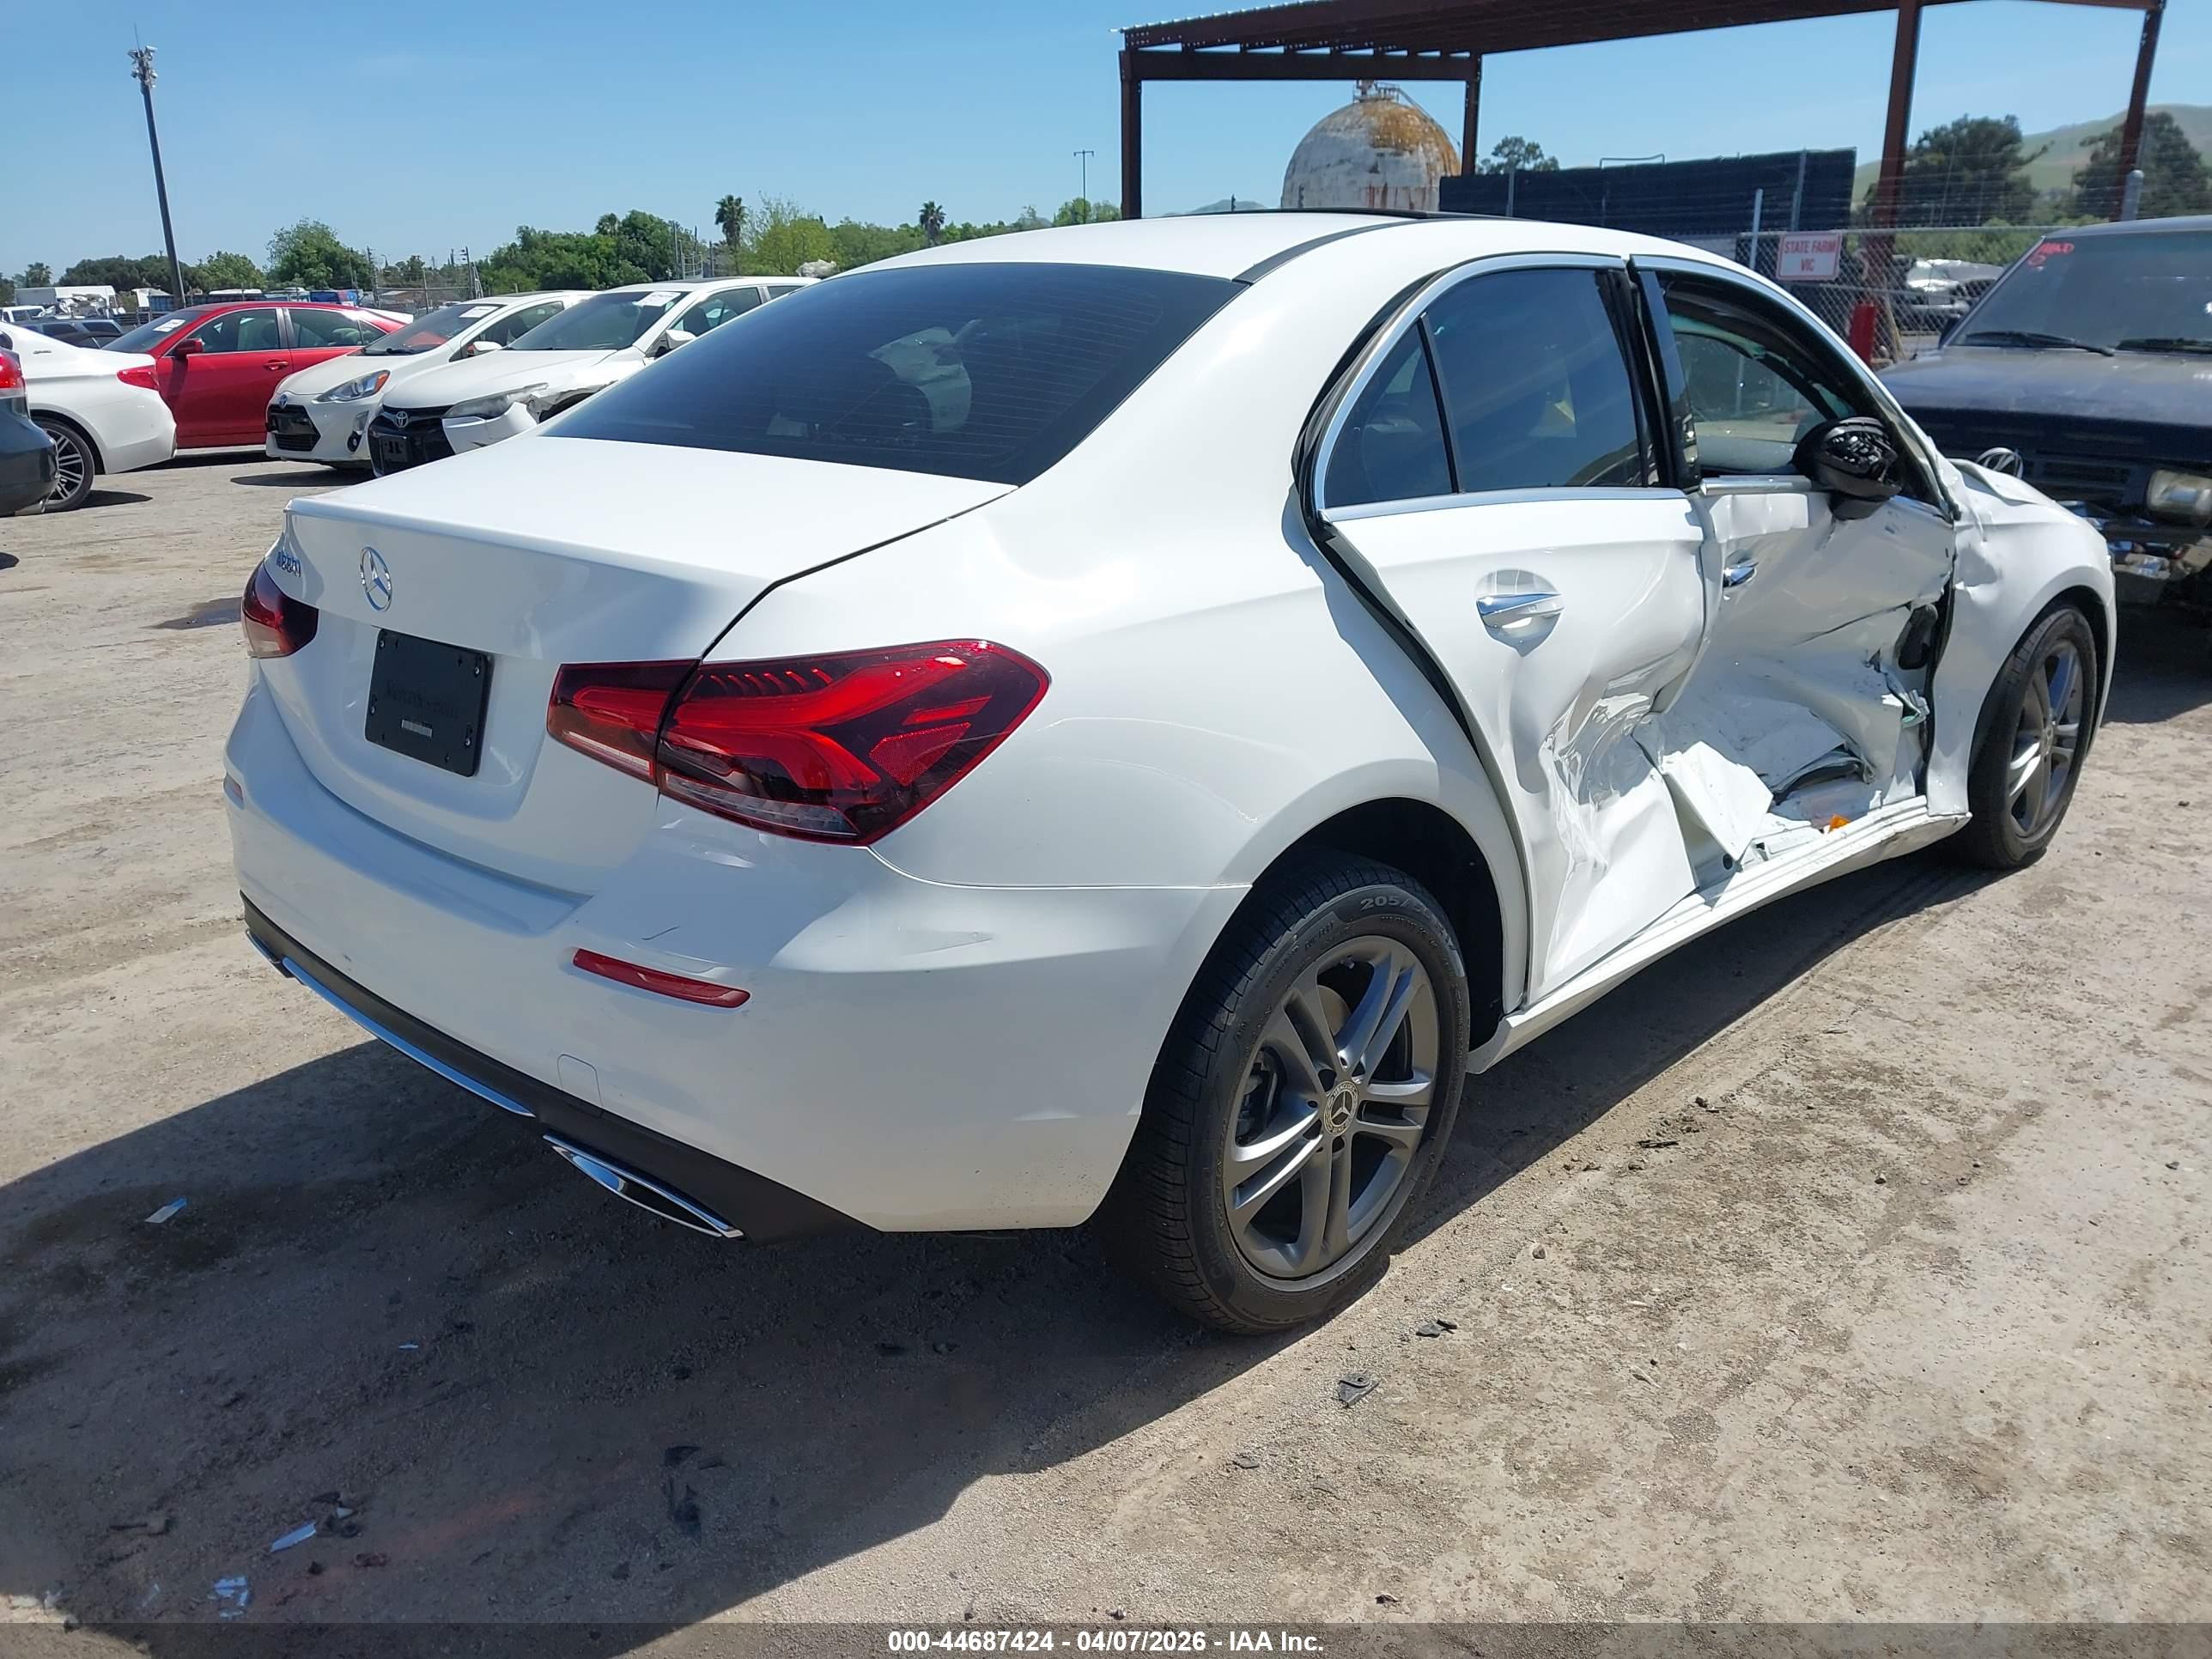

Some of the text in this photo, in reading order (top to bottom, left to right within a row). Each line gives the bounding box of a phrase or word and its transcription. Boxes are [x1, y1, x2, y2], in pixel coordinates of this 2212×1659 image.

[1784, 240, 1837, 253] STATE FARM
[1801, 258, 1814, 272] VIC
